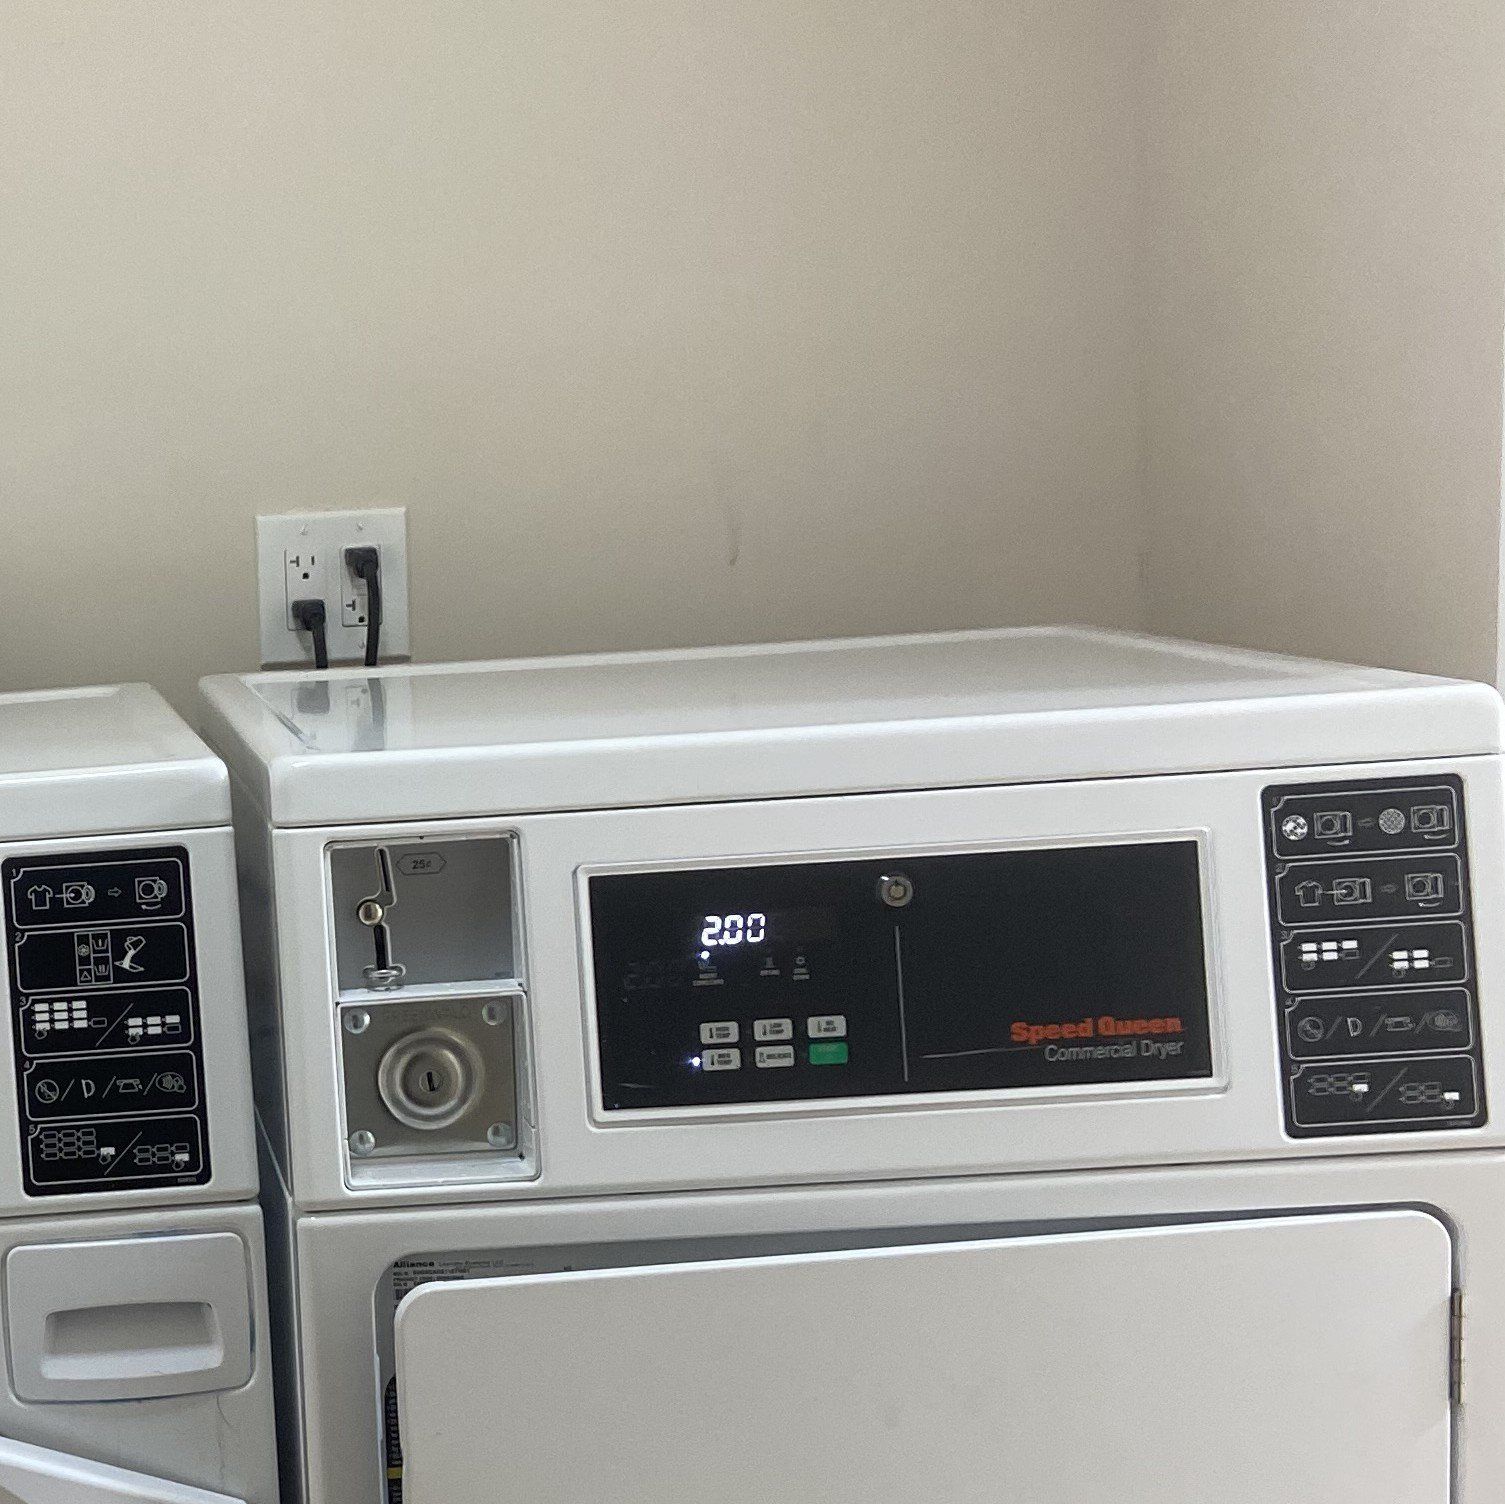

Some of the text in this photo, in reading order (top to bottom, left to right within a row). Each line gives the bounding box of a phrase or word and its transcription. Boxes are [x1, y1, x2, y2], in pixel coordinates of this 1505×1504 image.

[700, 913, 766, 946] 2.00
[14, 932, 23, 942] 2
[19, 996, 28, 1006] 3
[1010, 1015, 1183, 1046] Speed Queen
[1044, 1039, 1184, 1062] Commercial Dryer
[28, 1124, 37, 1133] 5
[392, 1260, 436, 1269] Alliance
